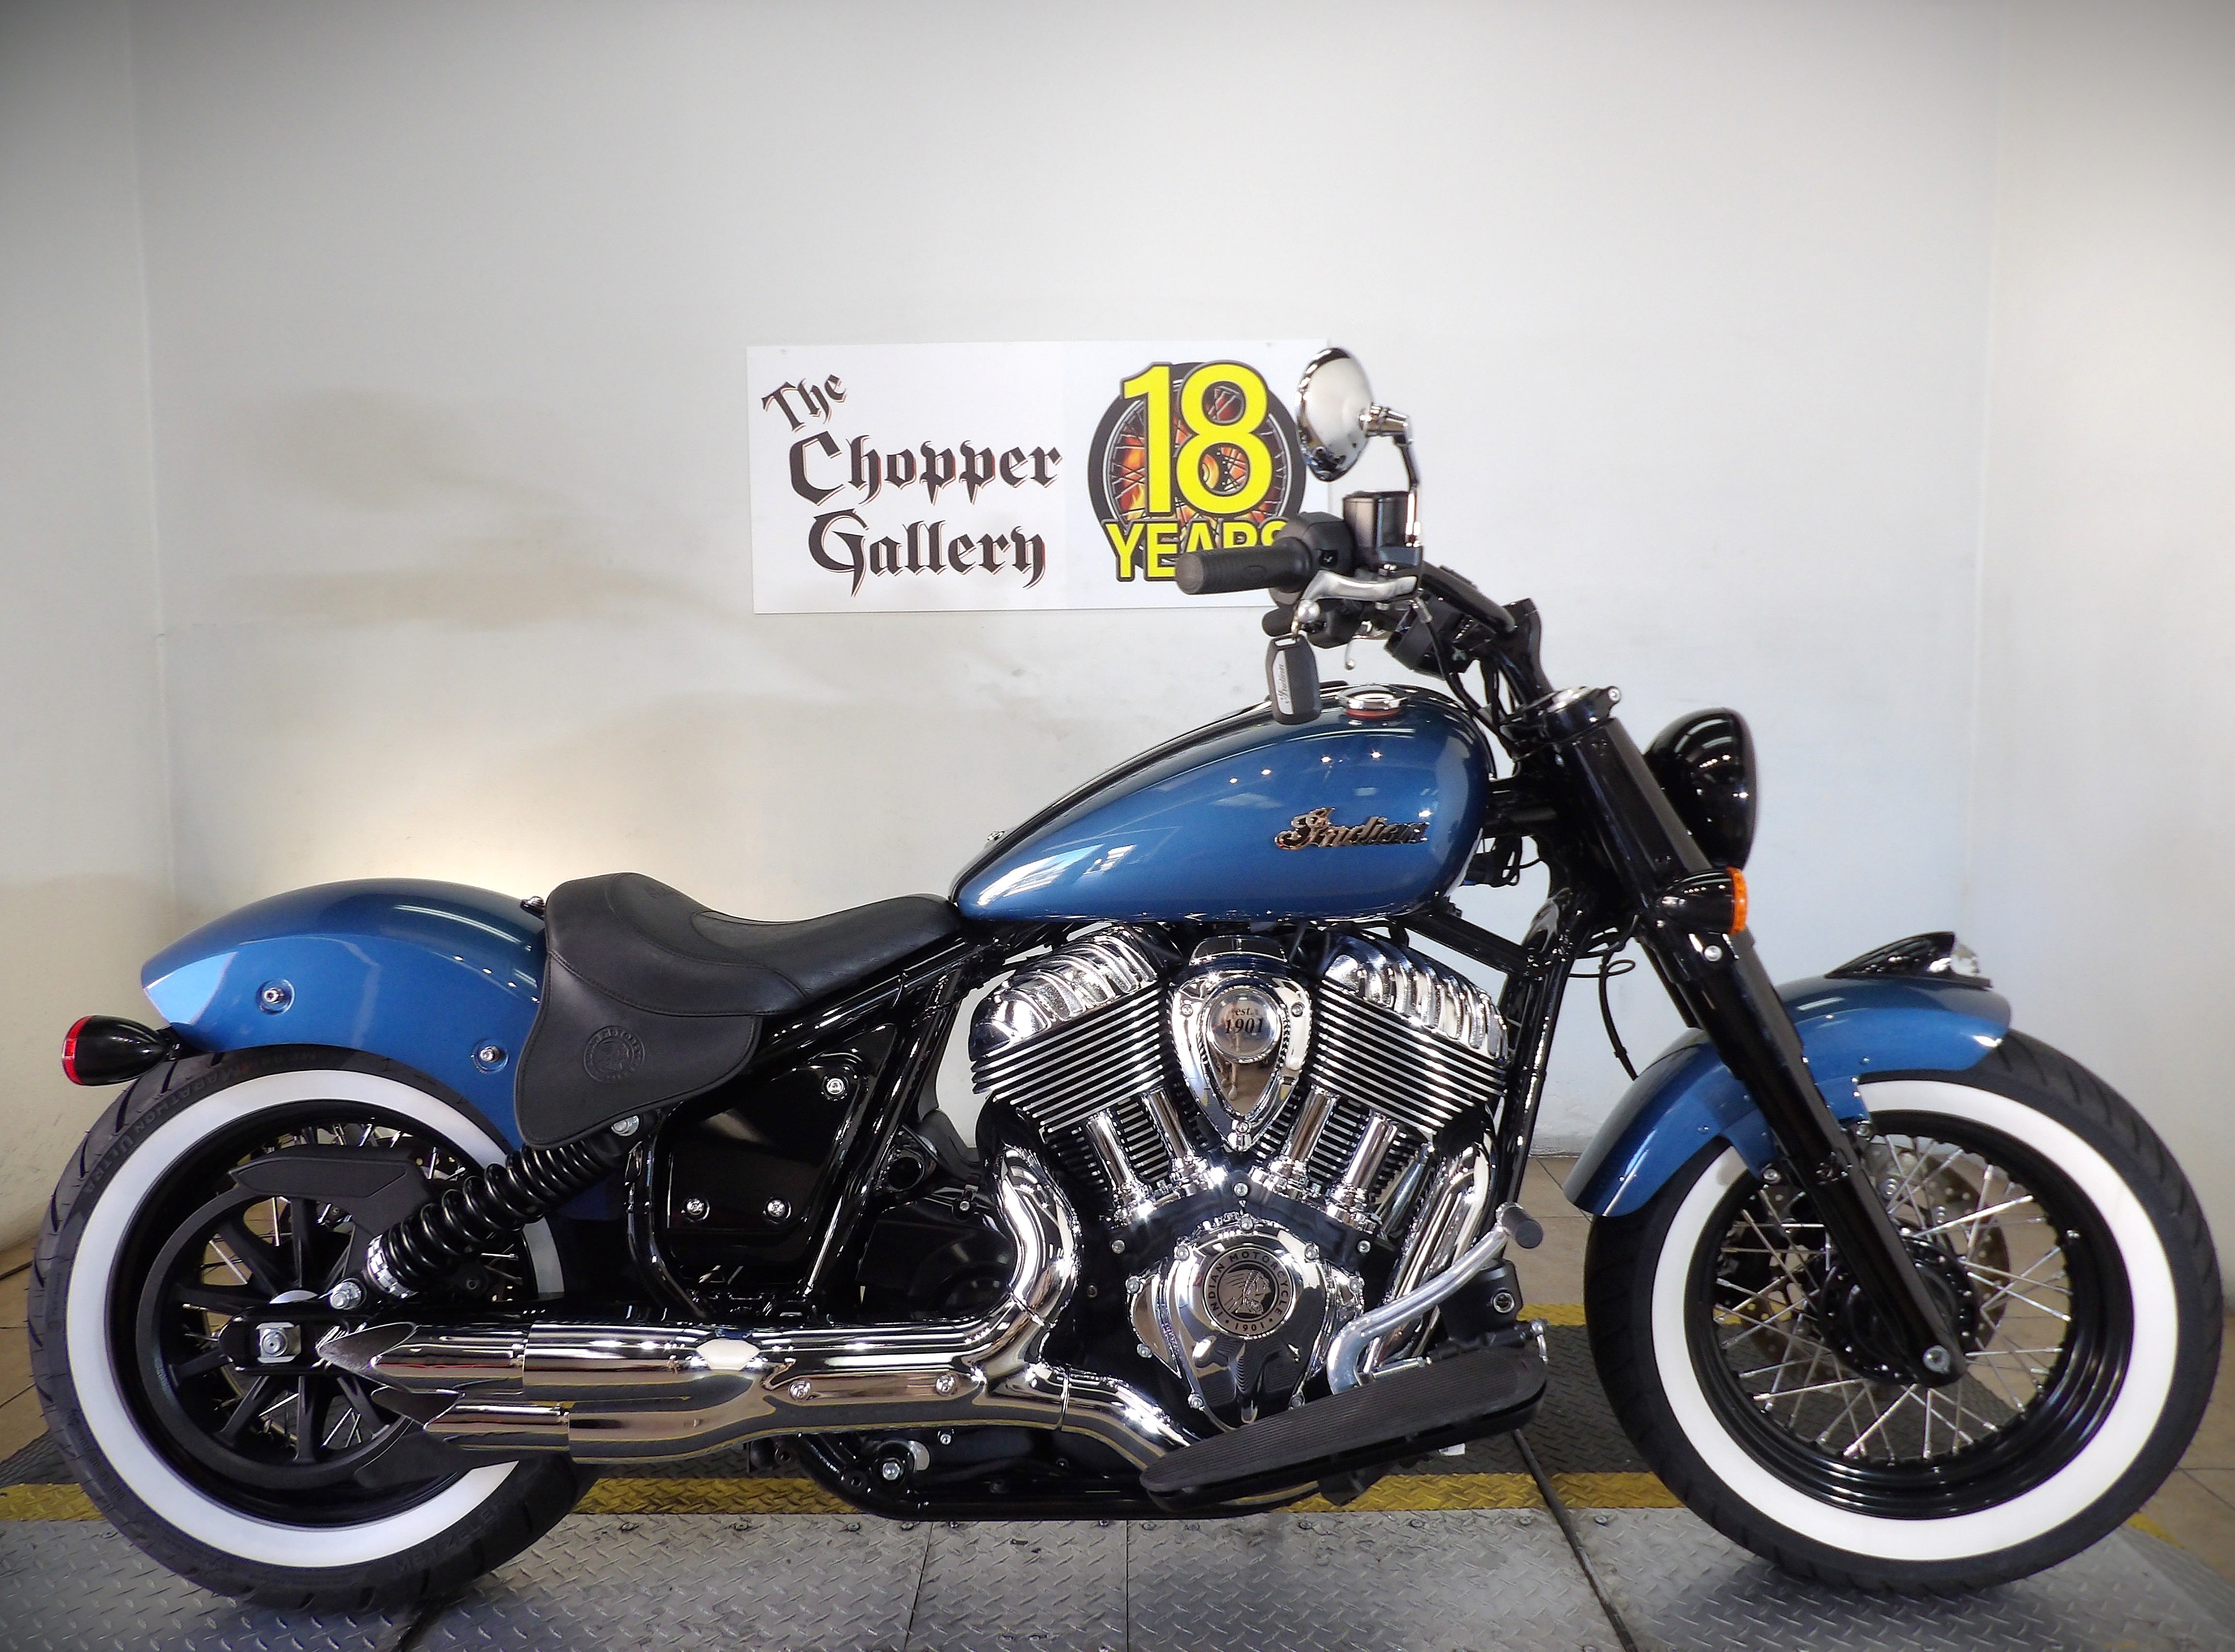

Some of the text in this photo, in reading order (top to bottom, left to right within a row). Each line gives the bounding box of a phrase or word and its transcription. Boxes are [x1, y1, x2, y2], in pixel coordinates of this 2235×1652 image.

[761, 373, 848, 433] The
[789, 430, 1063, 506] Chopper
[1120, 360, 1274, 518] 18
[808, 508, 1045, 598] Gallery
[1274, 807, 1430, 850] Indian
[1224, 1018, 1263, 1035] 1901
[1235, 1007, 1252, 1016] est.
[1208, 1251, 1289, 1317] INDIAN MOTORCYCLE
[1235, 1322, 1264, 1331] 1901
